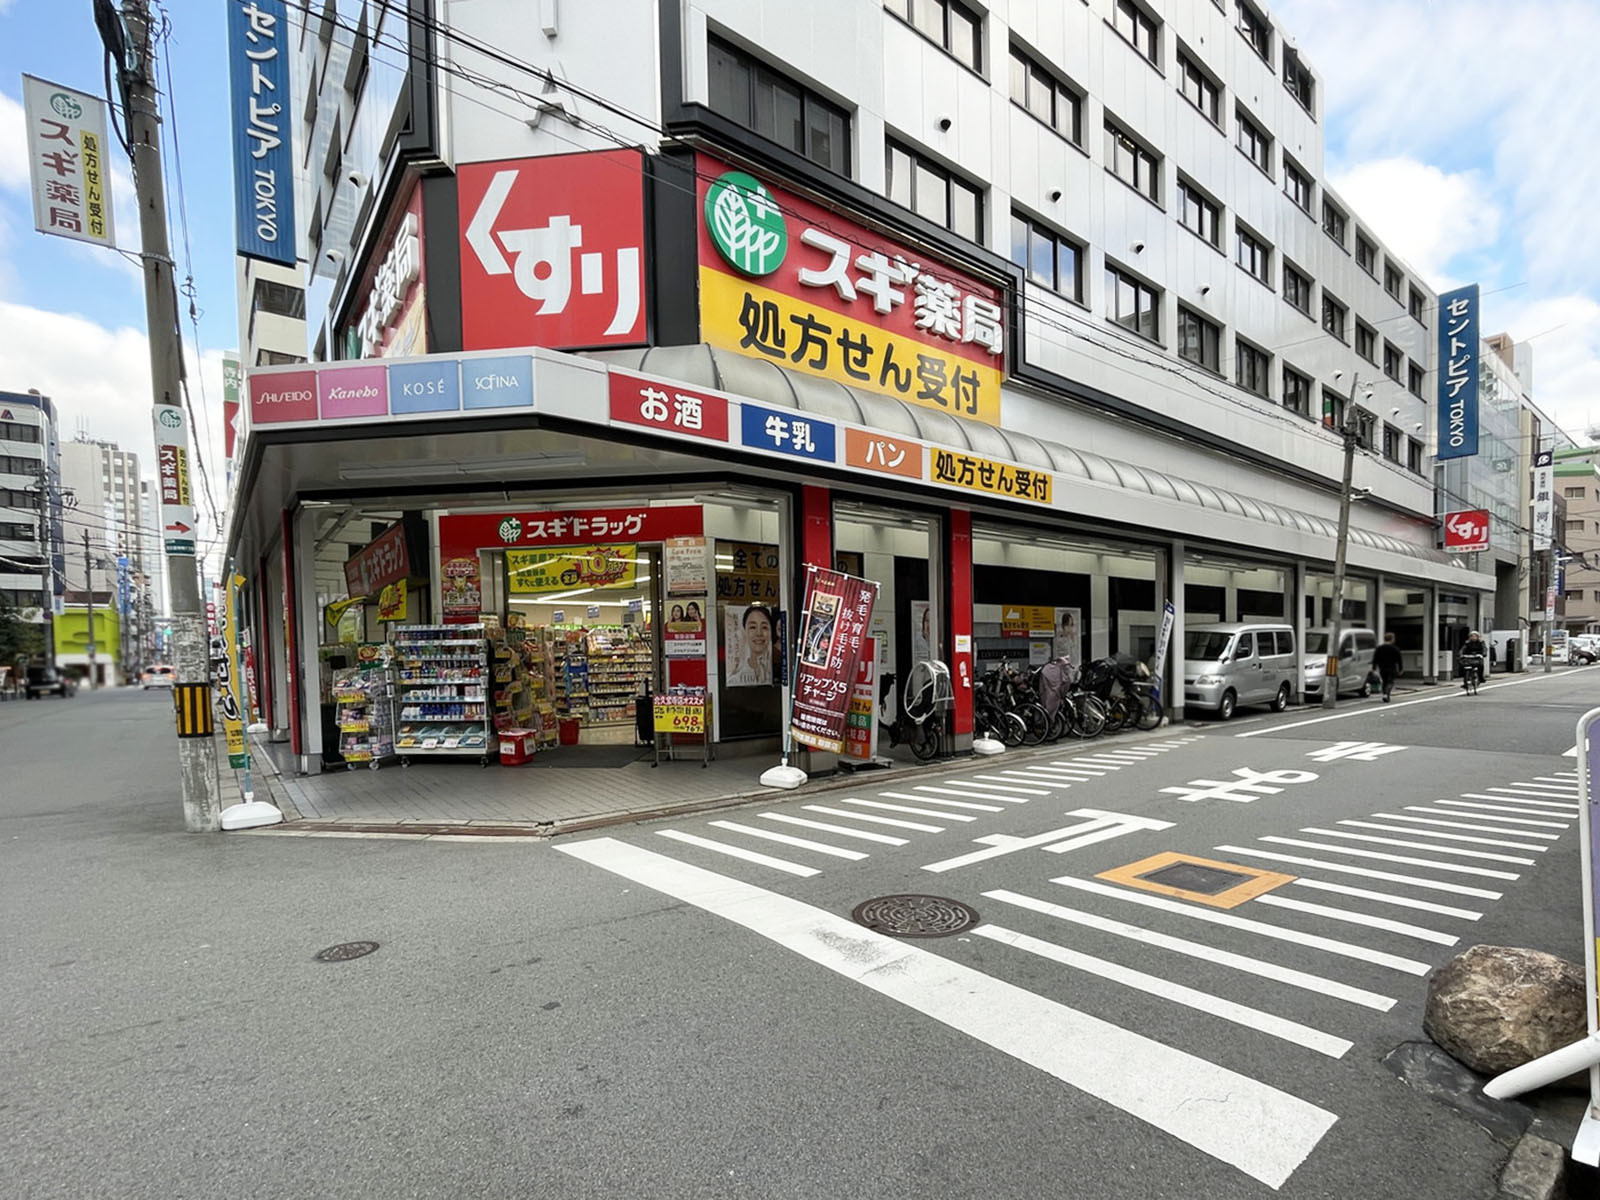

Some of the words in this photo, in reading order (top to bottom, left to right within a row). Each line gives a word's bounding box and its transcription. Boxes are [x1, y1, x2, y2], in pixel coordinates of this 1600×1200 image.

[242, 3, 281, 159] セントピア
[40, 118, 82, 233] スギ薬局
[84, 135, 103, 235] 処方せん受付
[255, 169, 277, 242] TOKYO
[465, 169, 640, 336] くすり
[799, 227, 1002, 356] スギ薬局
[739, 291, 981, 416] 処方せん受付
[1446, 299, 1470, 397] セントピア
[256, 390, 312, 404] SHISEIDO
[328, 386, 379, 400] Kanebo
[403, 378, 446, 396] KOSÉ
[475, 374, 519, 391] SOFINA
[639, 386, 703, 431] お酒
[1449, 400, 1465, 447] TOKYO
[765, 415, 815, 454] 牛乳
[865, 440, 906, 468] パン
[935, 449, 1049, 501] 処方せん受付
[527, 514, 647, 538] スギドラッグ
[1447, 514, 1488, 543] くすり
[830, 608, 854, 675] 抜け毛予防。
[849, 590, 871, 654] 発毛、育毛、
[800, 672, 848, 694] リアップX5
[803, 685, 837, 701] チャージ
[673, 715, 698, 726] 698
